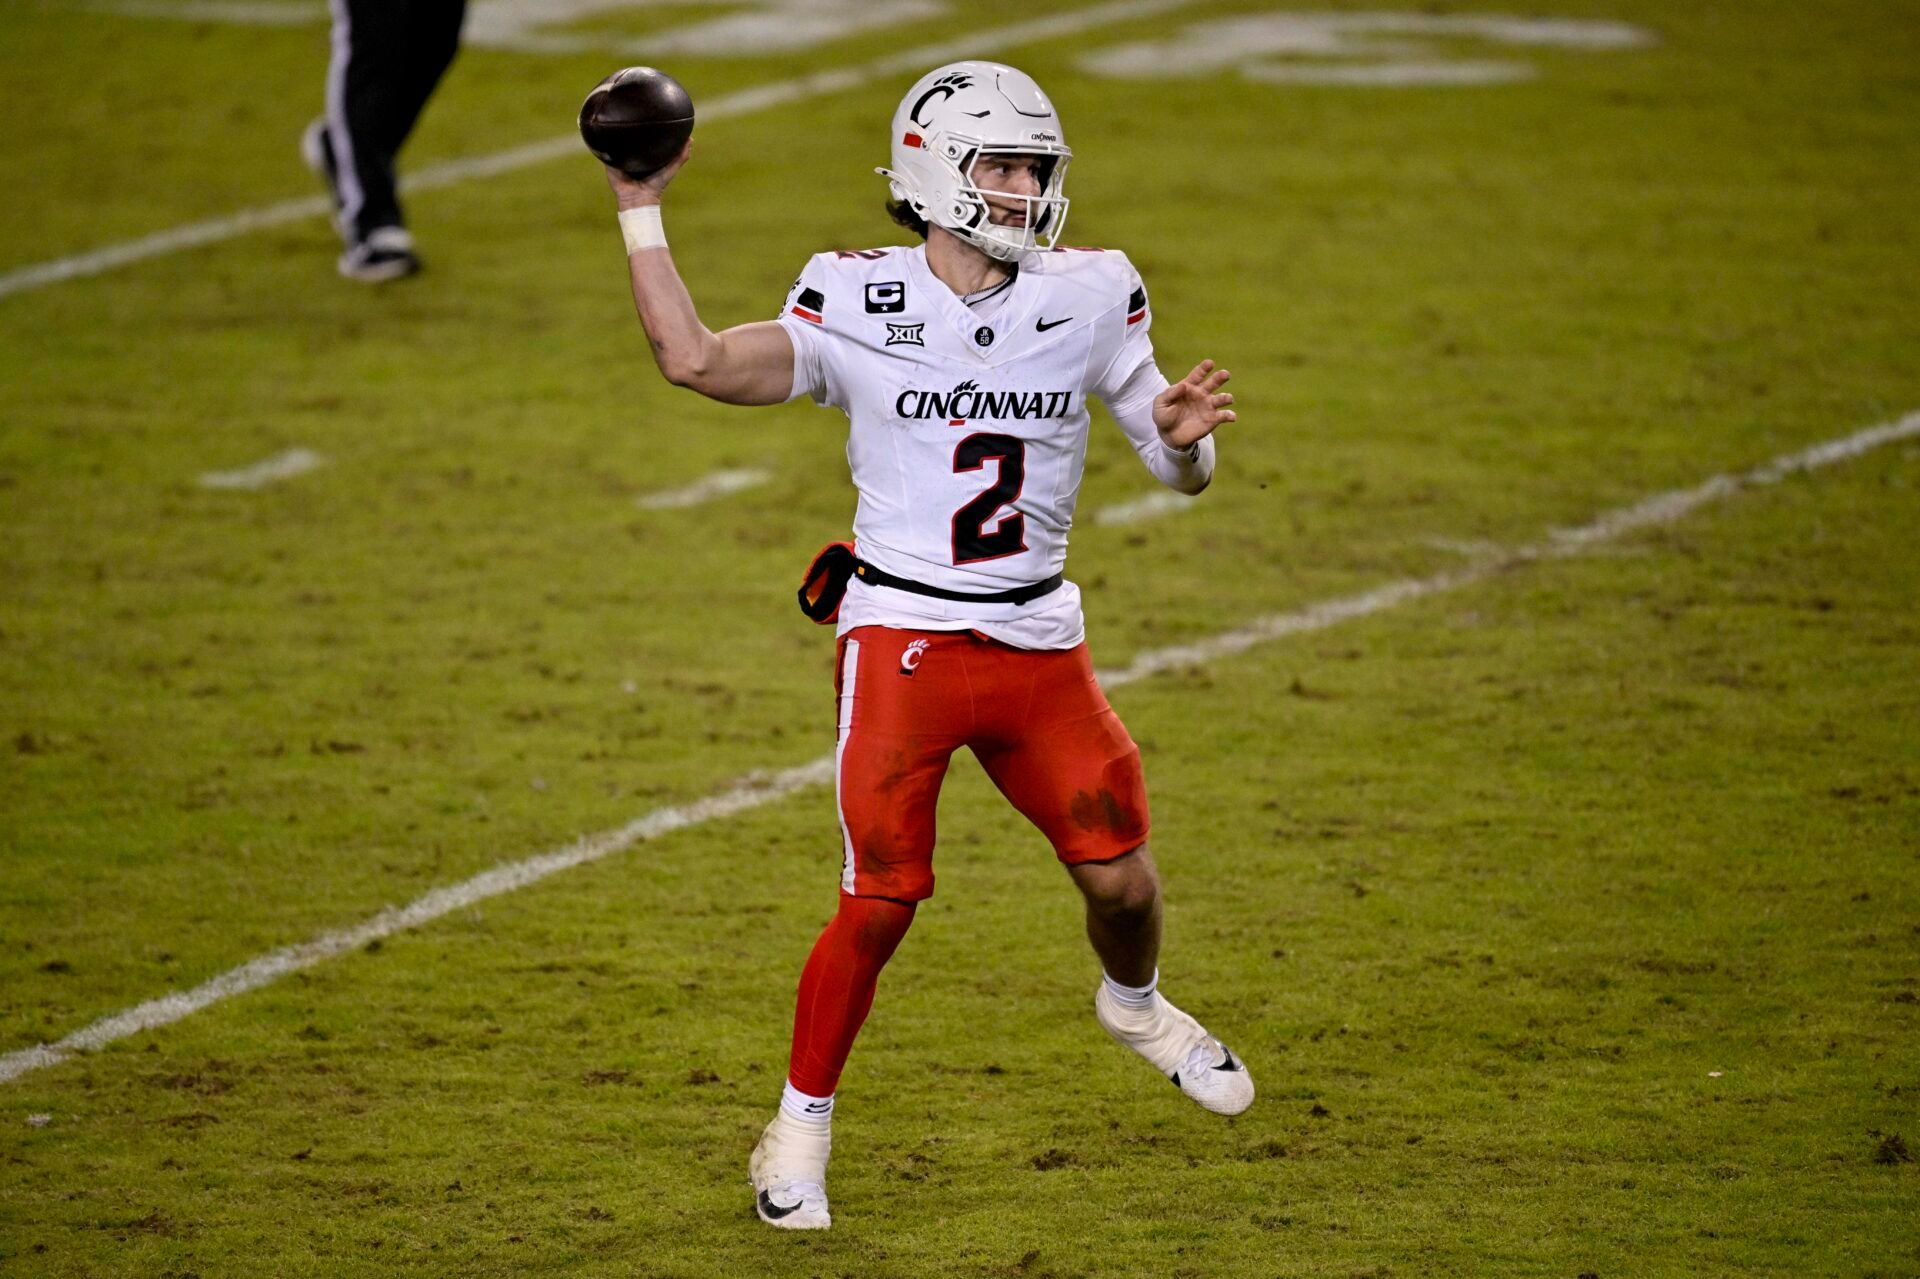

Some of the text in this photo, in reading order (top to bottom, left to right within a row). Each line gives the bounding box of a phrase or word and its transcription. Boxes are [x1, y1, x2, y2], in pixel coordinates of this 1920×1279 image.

[868, 283, 901, 304] C
[980, 328, 989, 336] JK
[980, 336, 990, 345] 58
[895, 388, 1073, 420] CINCINNATI
[951, 432, 1029, 566] 2
